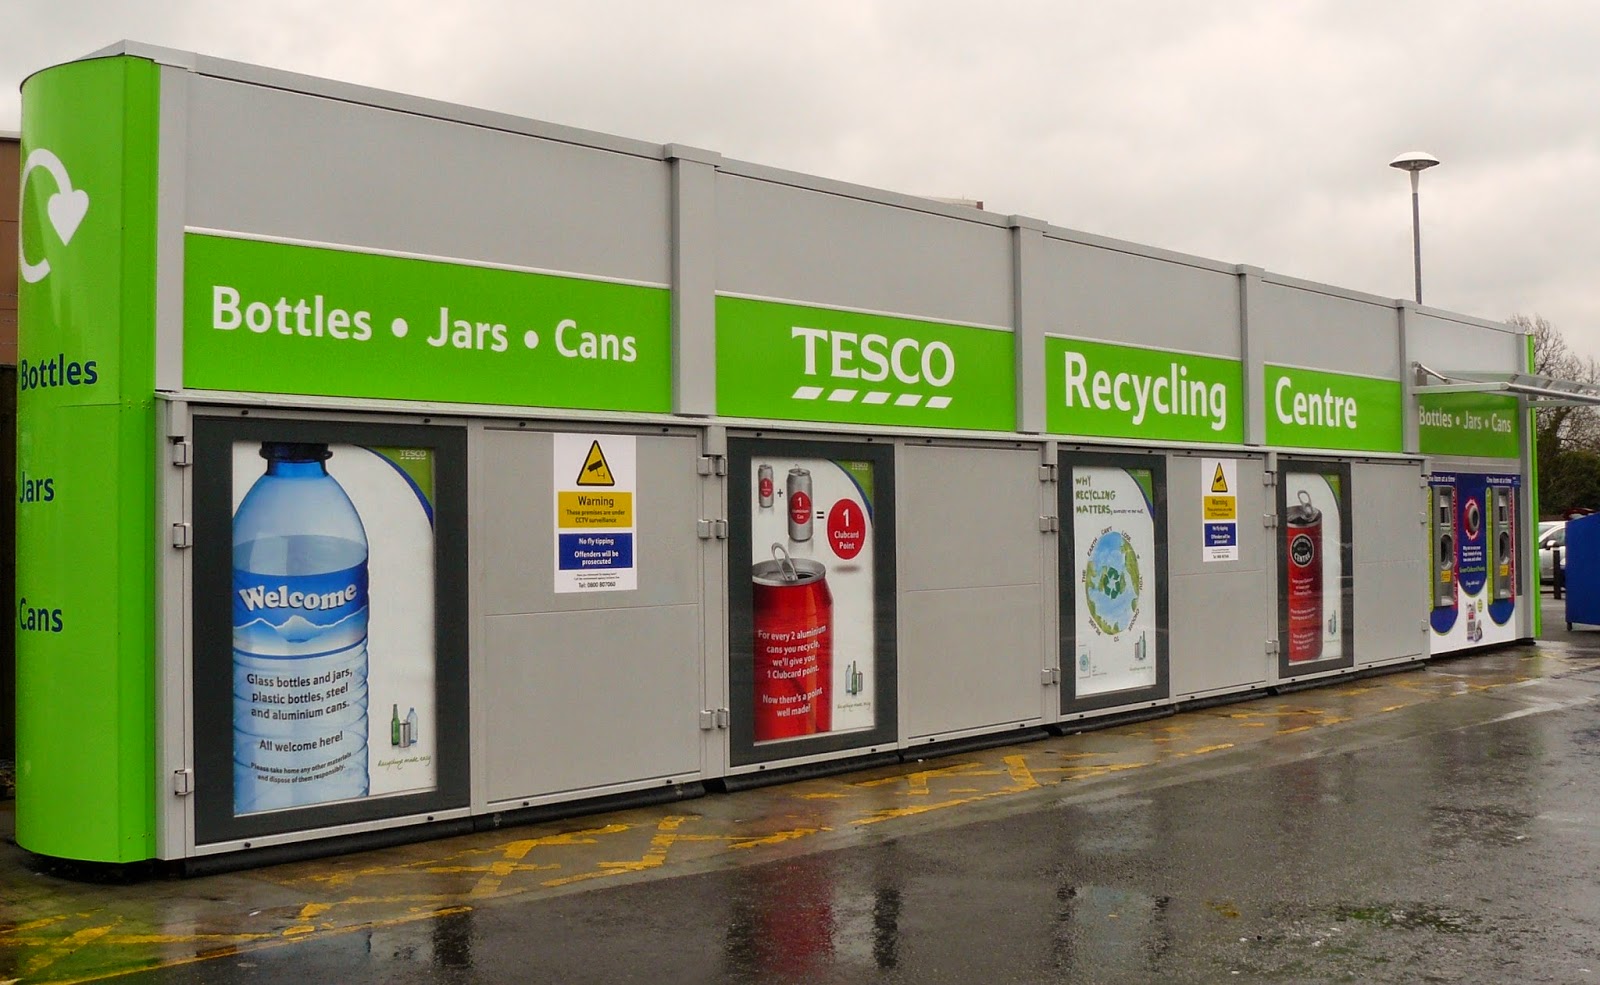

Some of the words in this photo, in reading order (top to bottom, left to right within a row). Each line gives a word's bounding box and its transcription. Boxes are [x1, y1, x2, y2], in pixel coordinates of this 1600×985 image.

[213, 285, 372, 341] Bottles
[427, 307, 508, 352] Jars
[555, 319, 637, 362] Cans
[791, 326, 955, 388] TESCO
[21, 353, 98, 391] Bottles
[1064, 350, 1227, 432] Recycling
[1273, 375, 1357, 430] Centre
[1419, 405, 1452, 428] Bottles
[1463, 410, 1482, 430] Jars
[1491, 413, 1512, 433] Cans
[19, 471, 55, 504] Jars
[1075, 475, 1091, 487] WHY
[578, 496, 614, 508] Warning
[1076, 489, 1116, 501] RECYCLING
[842, 508, 850, 527] 1
[595, 538, 614, 546] tipping
[834, 531, 859, 539] Clubcard
[840, 542, 855, 550] Point
[582, 558, 612, 566] prosecuted
[239, 583, 357, 611] Welcome
[19, 597, 64, 633] Cans
[758, 630, 770, 640] For
[771, 631, 789, 642] every
[791, 632, 795, 640] 2
[796, 626, 826, 640] aluminium
[767, 645, 782, 653] cans
[784, 645, 796, 655] you
[772, 658, 788, 666] we'll
[790, 658, 803, 668] give
[804, 655, 816, 666] you
[247, 673, 274, 687] Glass
[276, 676, 310, 688] bottles
[313, 672, 330, 685] and
[332, 668, 352, 684] jars,
[767, 670, 770, 678] 1
[772, 669, 801, 679] Clubcard
[802, 665, 819, 676] point.
[252, 692, 285, 704] plastic
[288, 692, 324, 704] bottles,
[326, 682, 348, 699] steel
[762, 694, 778, 704] Now
[779, 691, 801, 704] there's
[808, 687, 823, 700] point
[251, 708, 270, 718] and
[272, 708, 324, 720] aluminium
[326, 700, 350, 714] cans.
[777, 708, 790, 717] well
[791, 704, 811, 715] made!
[260, 740, 272, 751] All
[275, 741, 317, 752] welcome
[320, 730, 343, 748] here!
[250, 762, 269, 772] Please
[270, 766, 282, 774] take
[312, 762, 326, 772] other
[327, 752, 352, 767] materials
[270, 776, 290, 784] dispose
